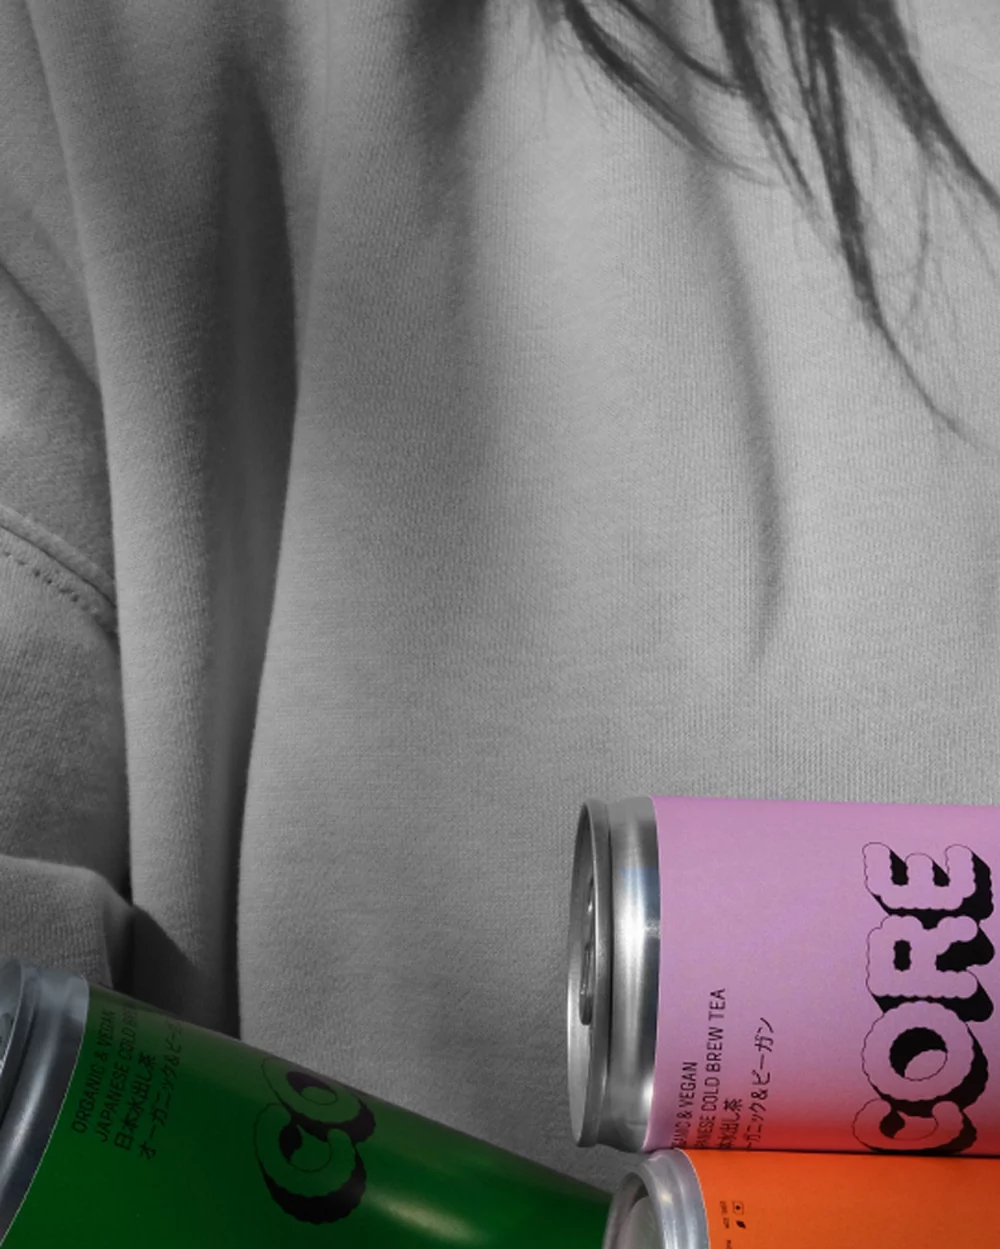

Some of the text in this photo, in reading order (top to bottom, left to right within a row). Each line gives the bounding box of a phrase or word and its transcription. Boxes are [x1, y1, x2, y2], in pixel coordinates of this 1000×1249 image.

[708, 988, 726, 1021] TEA
[852, 842, 996, 1153] CORE
[71, 1010, 116, 1134] ORGANIC & VEGAN
[705, 1026, 724, 1073] BREW
[95, 1062, 130, 1143] JAPANESE
[118, 1026, 136, 1061] COLD
[114, 1050, 157, 1151] 日本水出し茶
[679, 1061, 698, 1108] VEGAN
[701, 1076, 721, 1112] COLD
[676, 1109, 693, 1120] &
